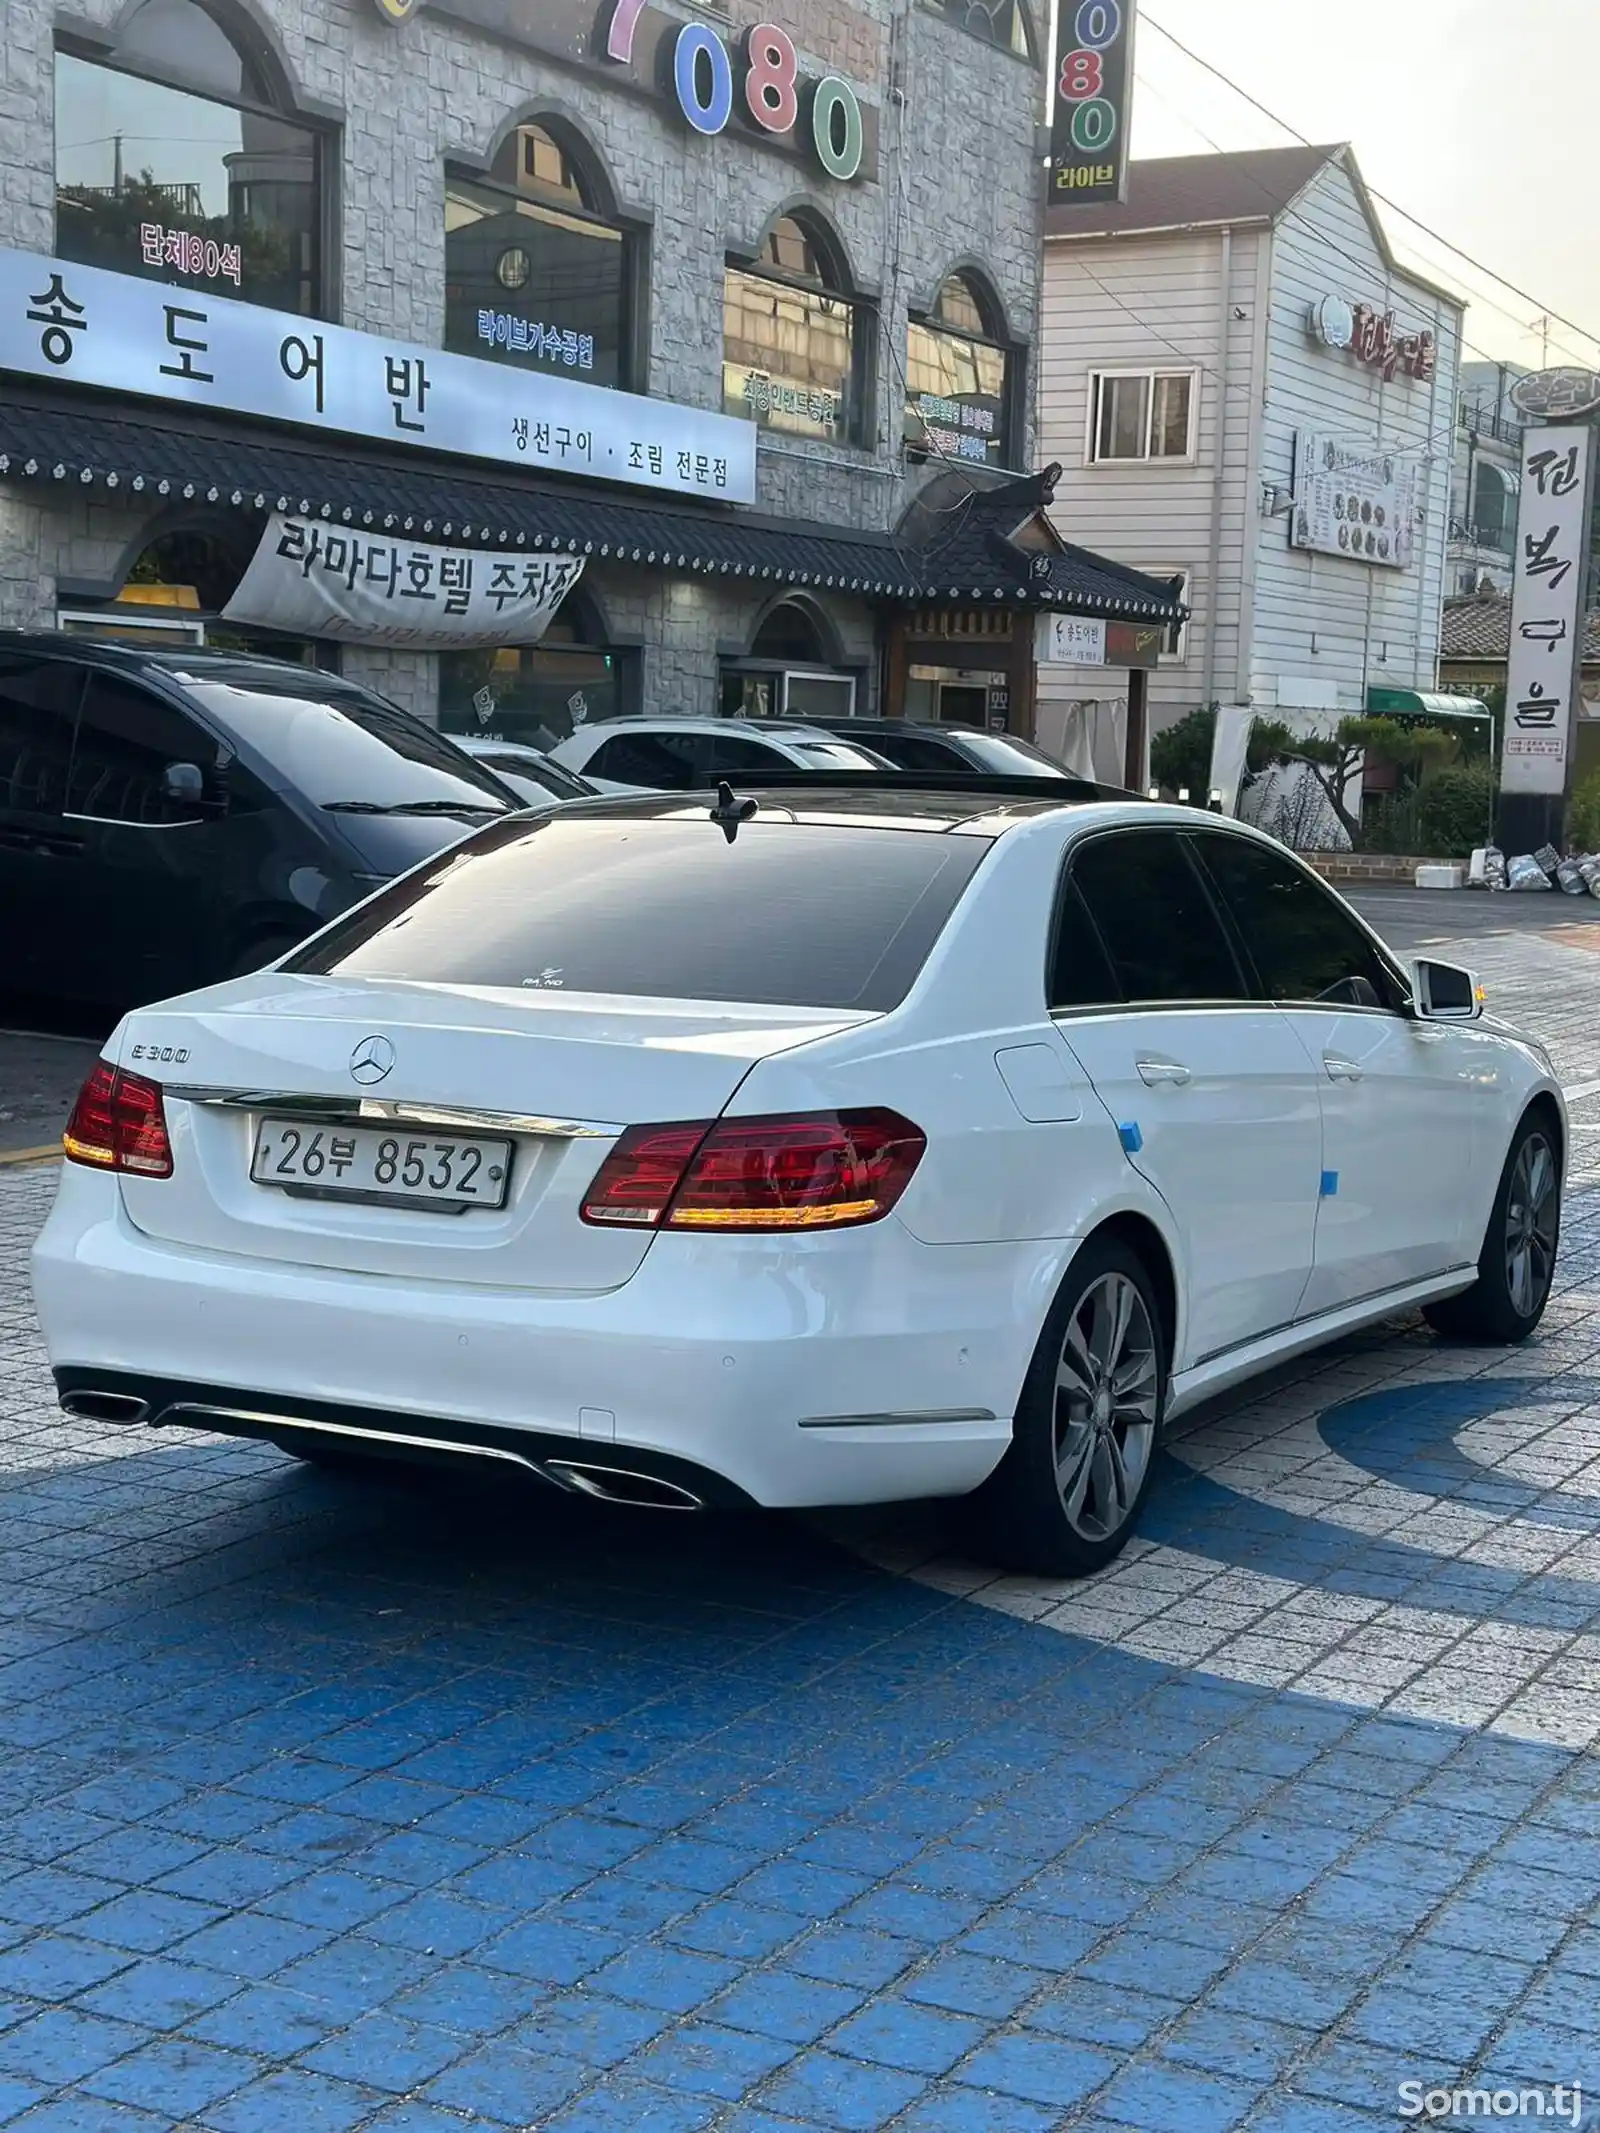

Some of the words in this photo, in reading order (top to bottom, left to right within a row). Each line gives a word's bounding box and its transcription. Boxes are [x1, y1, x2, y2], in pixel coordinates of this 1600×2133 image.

[1056, 164, 1114, 190] 라이브
[141, 222, 241, 286] 단체80석
[478, 309, 593, 369] 라이브가수공연
[511, 417, 592, 462] 생선구이
[627, 441, 662, 475] 조림
[676, 451, 727, 488] 전문점
[276, 522, 473, 615] 라마다호텔
[276, 1129, 356, 1177] 26부
[374, 1139, 482, 1193] 8532
